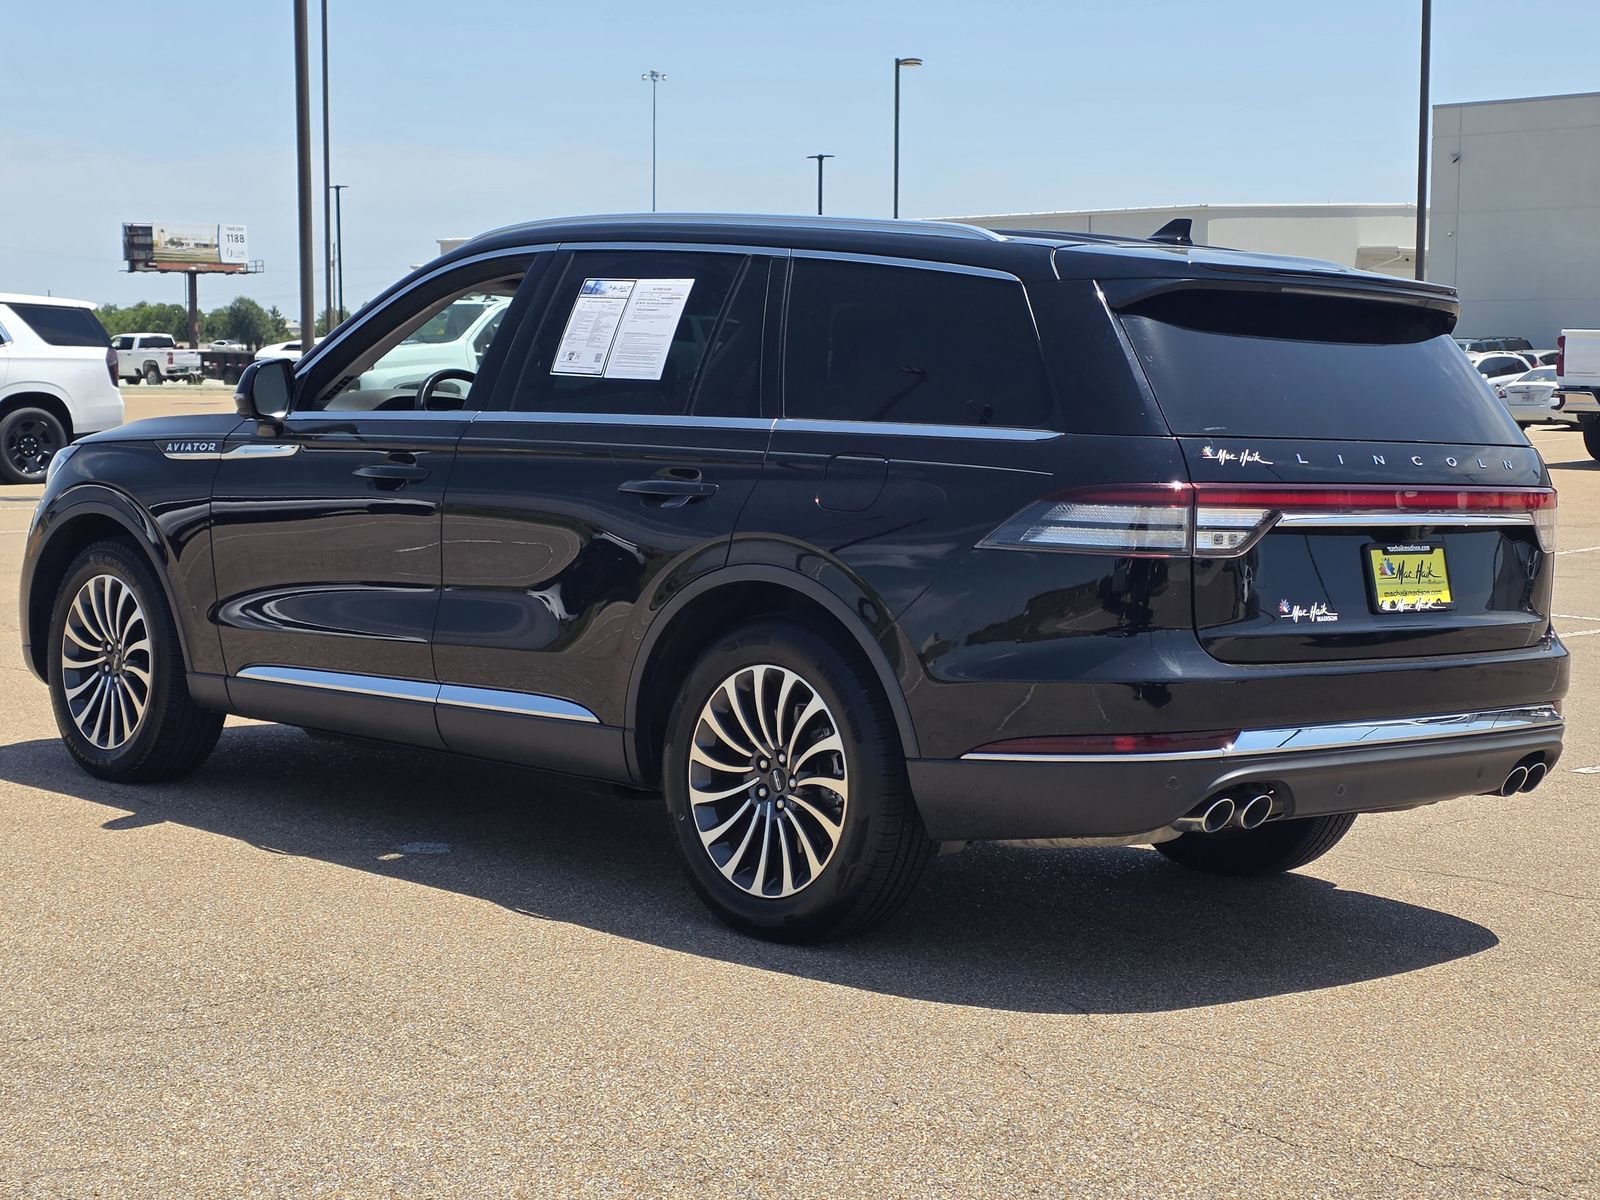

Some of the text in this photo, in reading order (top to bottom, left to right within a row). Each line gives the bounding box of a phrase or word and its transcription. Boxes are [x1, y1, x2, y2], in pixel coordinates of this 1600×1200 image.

[166, 442, 216, 451] AVIATOR
[1296, 453, 1513, 470] LINCOLN
[1388, 560, 1440, 584] Mac Haik
